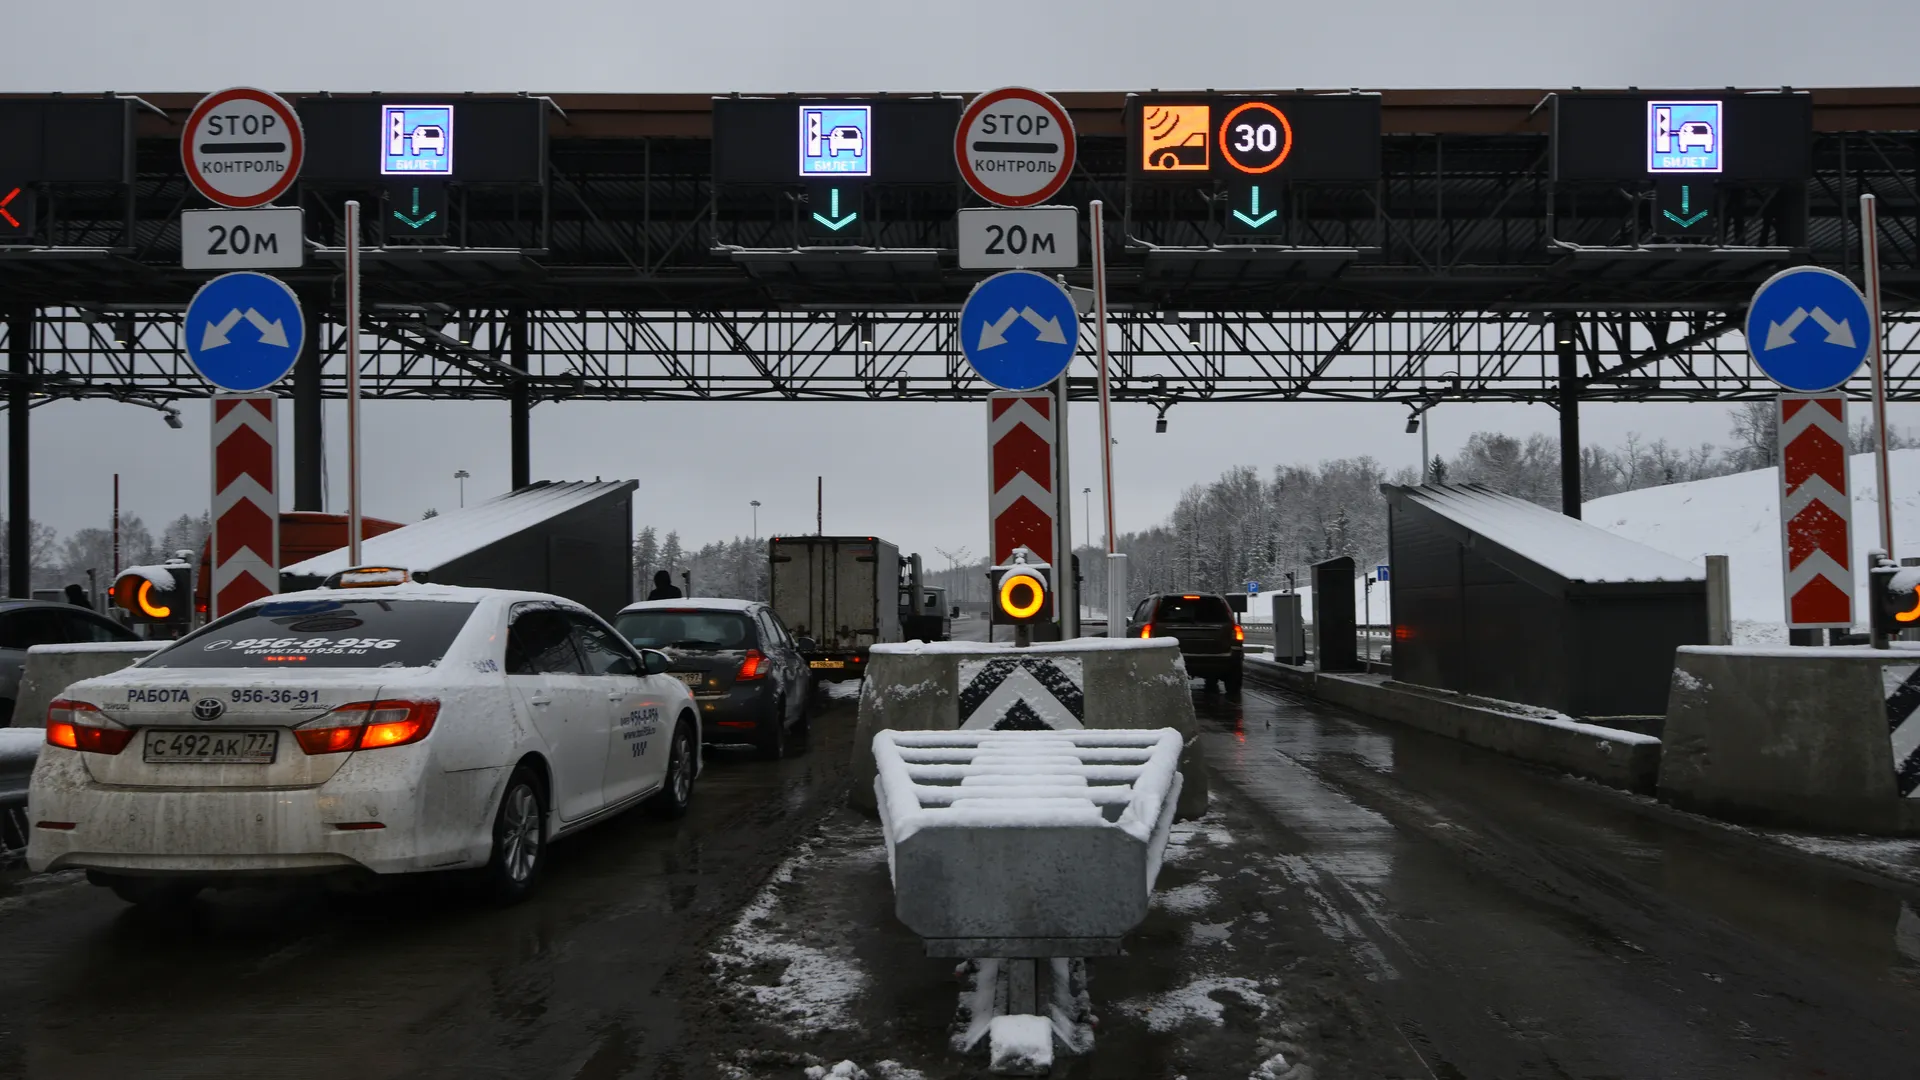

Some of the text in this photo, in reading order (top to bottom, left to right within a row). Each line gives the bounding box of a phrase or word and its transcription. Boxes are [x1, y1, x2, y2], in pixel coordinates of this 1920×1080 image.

[208, 115, 276, 136] STOP
[981, 114, 1050, 136] STOP
[1234, 124, 1277, 152] 30
[202, 160, 285, 173] КОНТРОЛЬ
[395, 159, 440, 170] БИЛЕТ
[814, 160, 858, 171] БИЛЕТ
[975, 159, 1057, 173] КОНТРОЛЬ
[1663, 156, 1709, 167] БИЛЕТ
[231, 638, 401, 649] 956-8-956
[127, 690, 190, 703] РАБОТА
[231, 690, 319, 703] 956-36-91
[247, 733, 270, 750] 77
